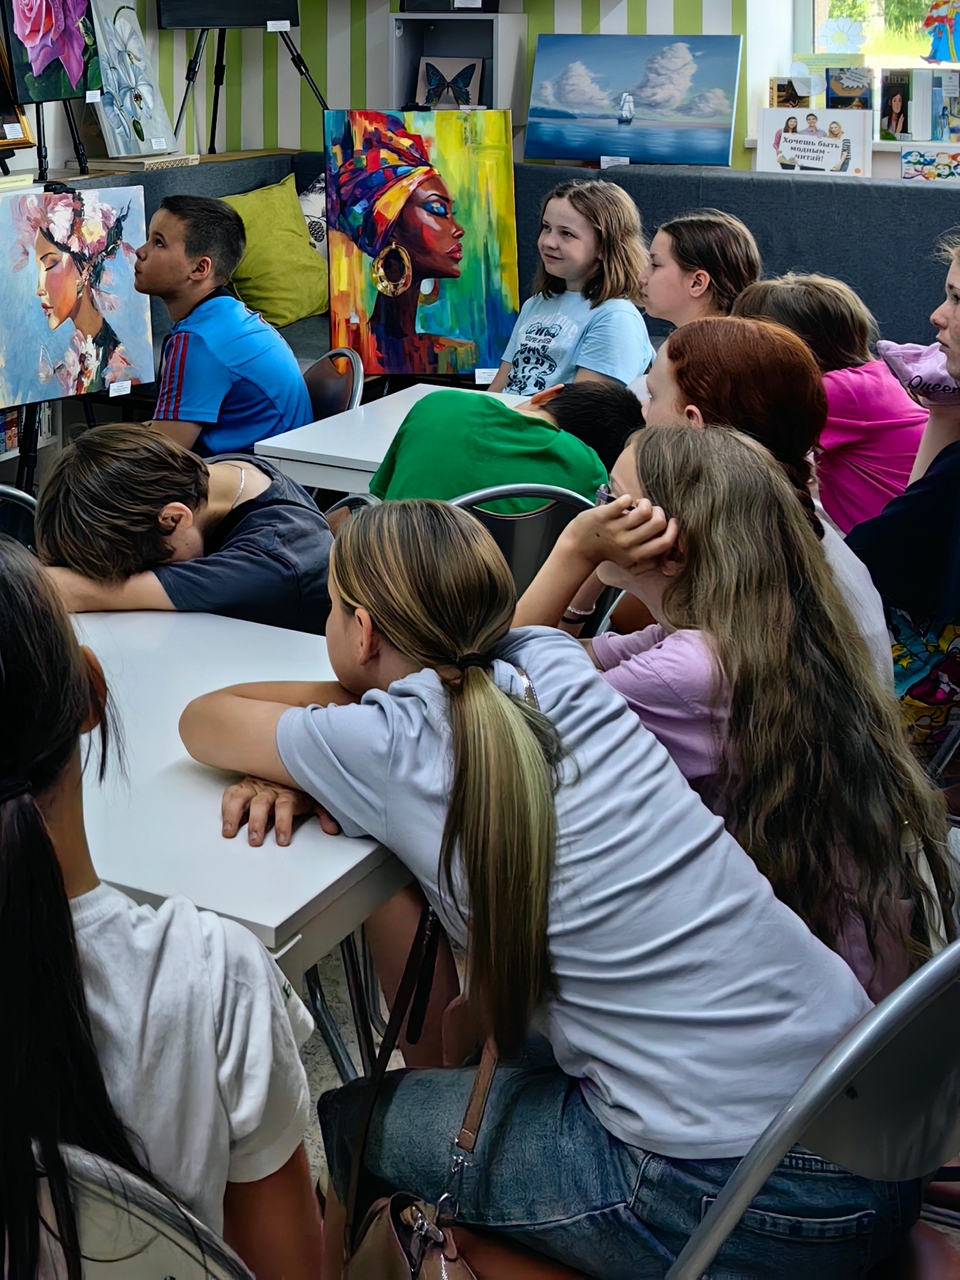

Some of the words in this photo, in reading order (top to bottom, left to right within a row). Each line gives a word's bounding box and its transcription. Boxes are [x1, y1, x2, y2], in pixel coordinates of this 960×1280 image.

[783, 136, 816, 147] Хочешь
[818, 140, 840, 149] быть
[790, 145, 825, 155] модным
